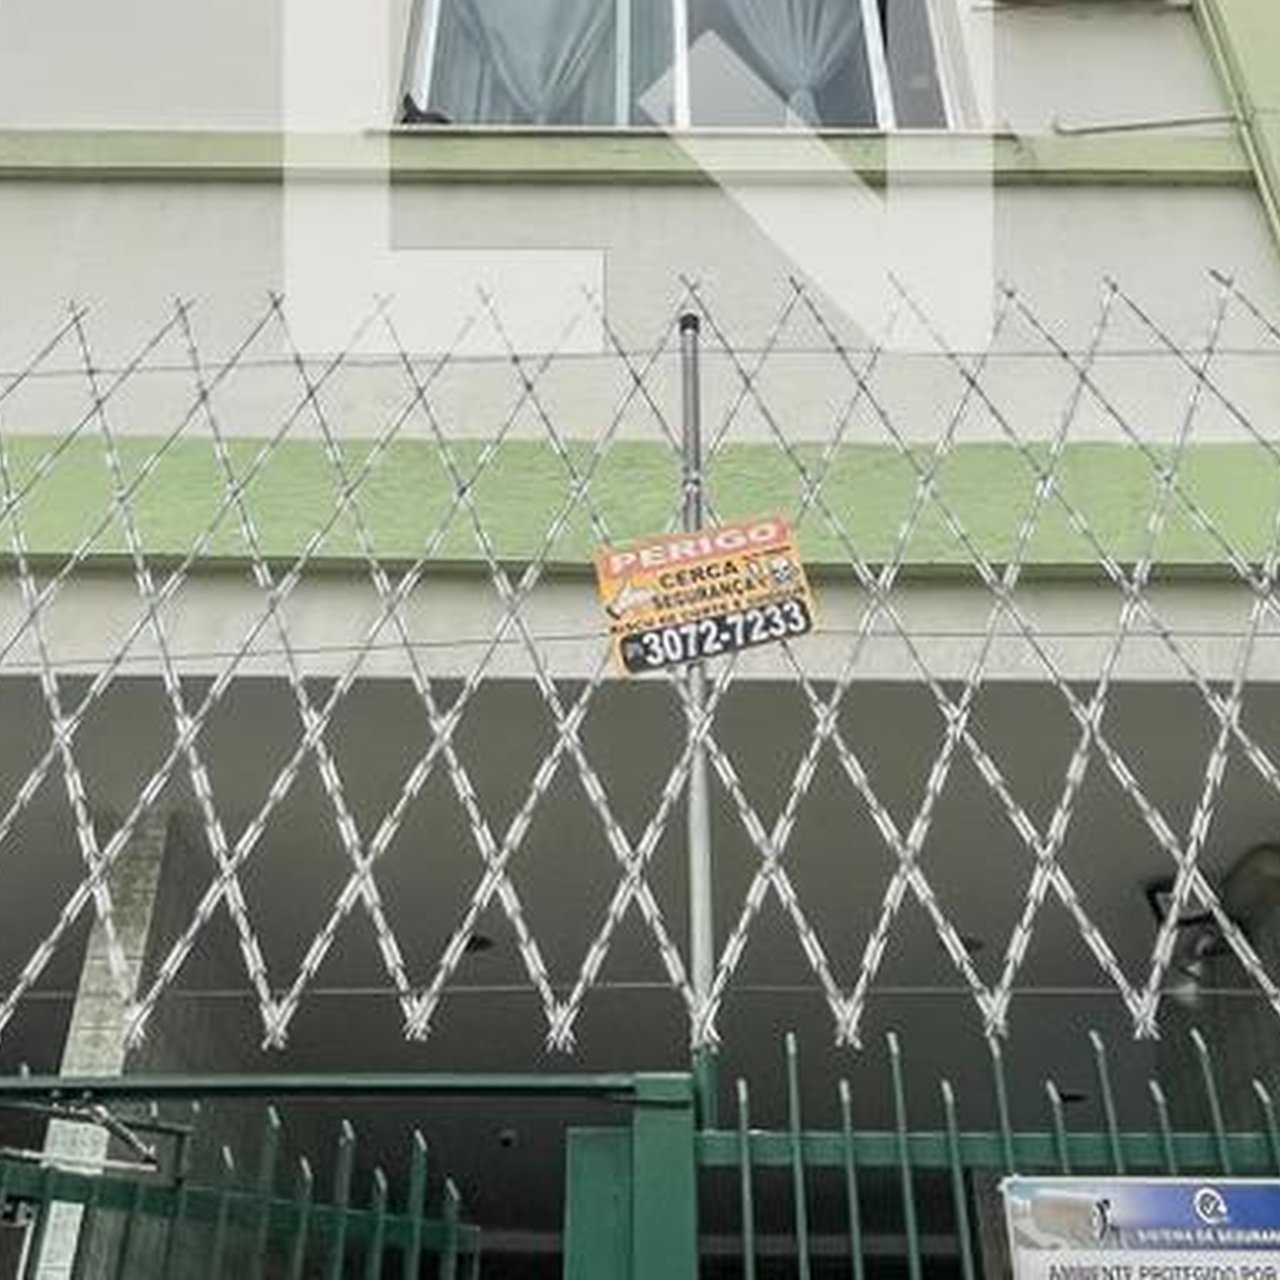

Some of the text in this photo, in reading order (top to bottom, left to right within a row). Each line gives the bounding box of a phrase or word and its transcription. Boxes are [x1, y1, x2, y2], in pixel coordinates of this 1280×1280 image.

[609, 524, 777, 573] PERIGO
[659, 561, 739, 589] CERCA
[652, 578, 757, 608] SEGURANÇA
[642, 603, 806, 665] 3072-7233
[1136, 1228, 1194, 1243] SISTEMA
